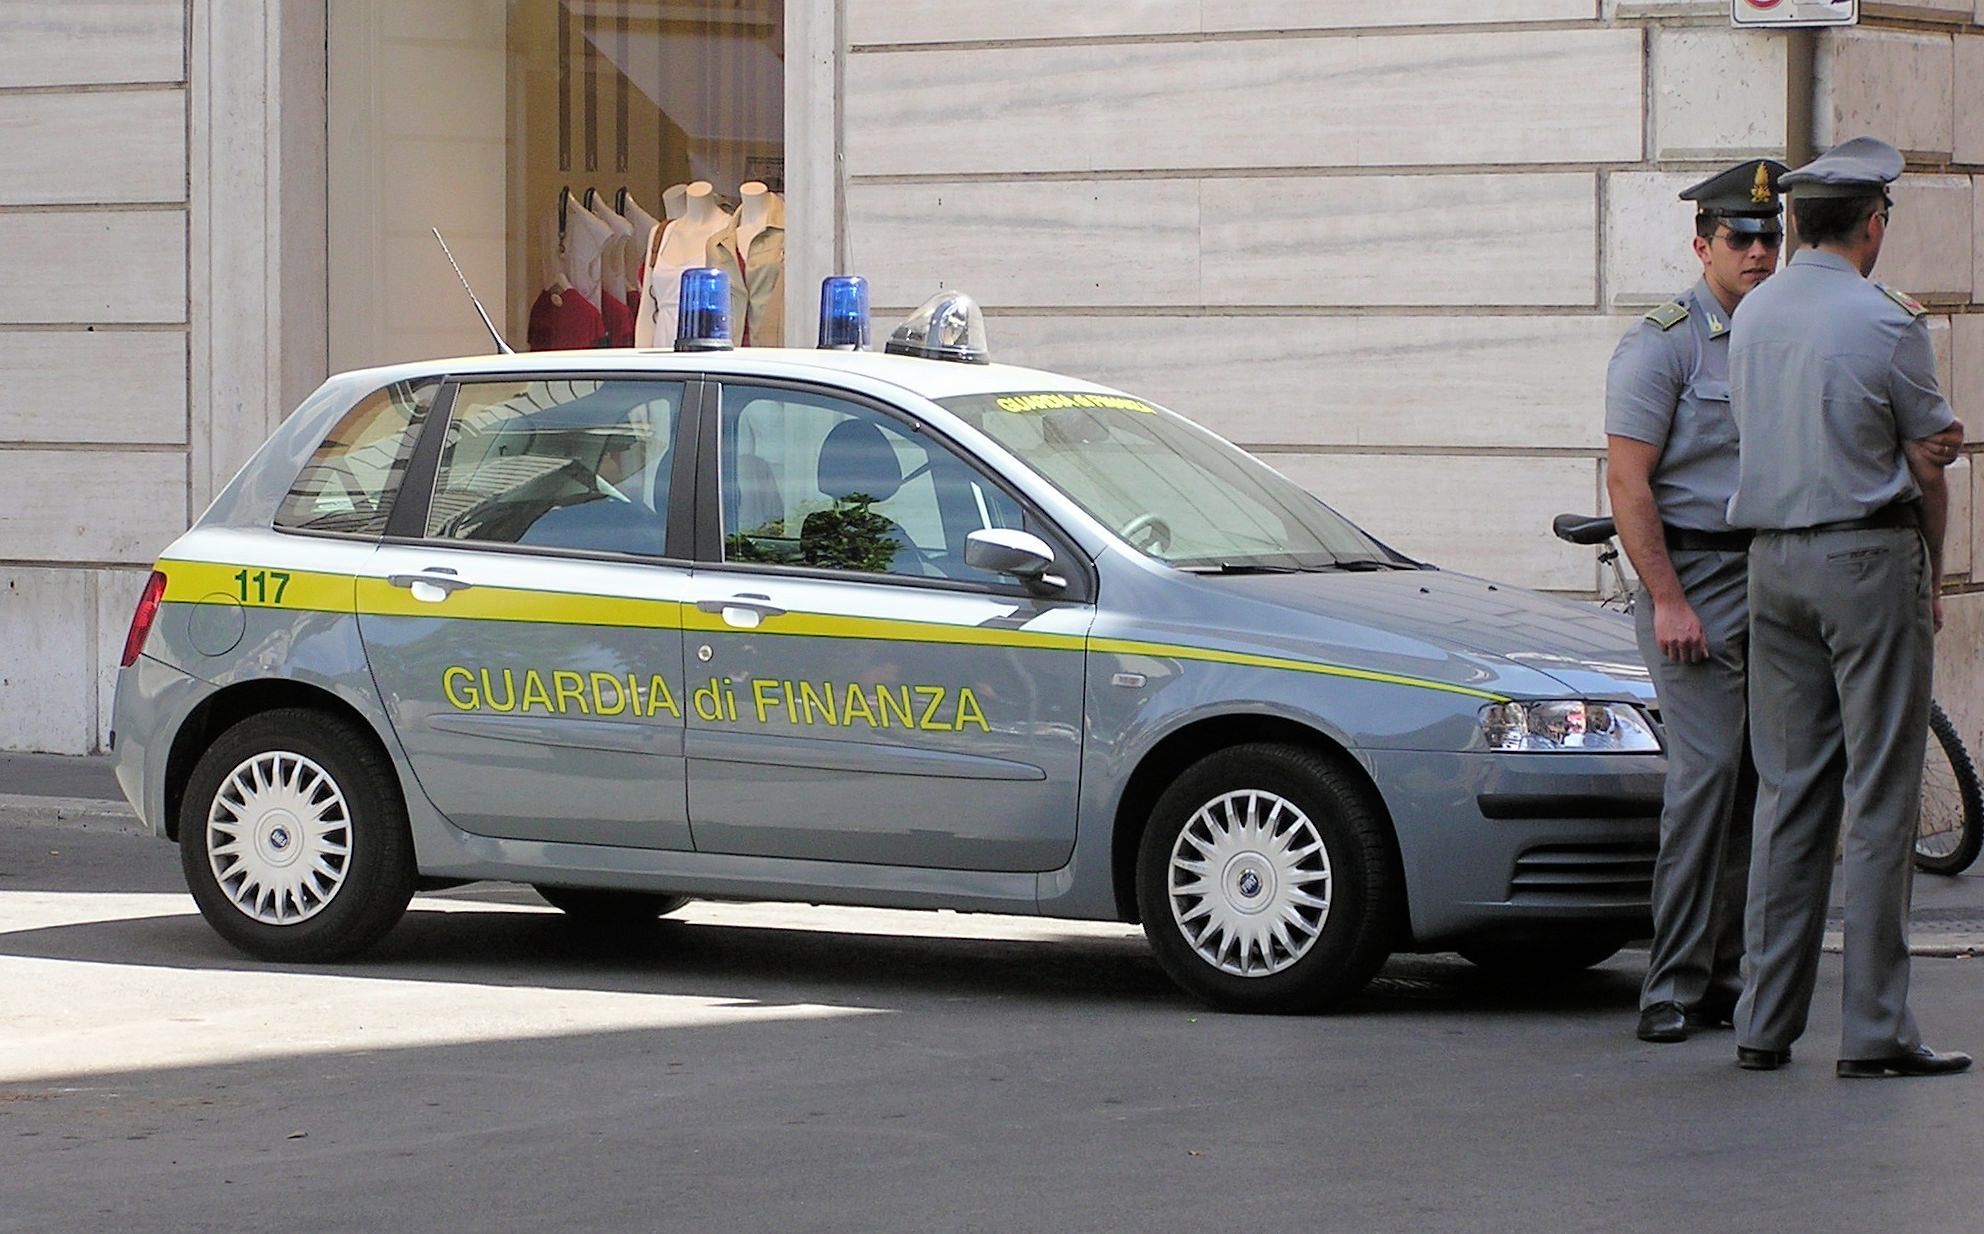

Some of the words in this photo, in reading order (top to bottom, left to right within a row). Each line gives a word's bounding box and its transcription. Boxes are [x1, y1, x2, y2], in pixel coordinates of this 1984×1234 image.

[996, 394, 1079, 413] GUARDIA
[235, 569, 290, 604] 117
[442, 665, 681, 718] GUARDIA
[693, 676, 738, 722] di
[751, 678, 991, 733] FINANZA
